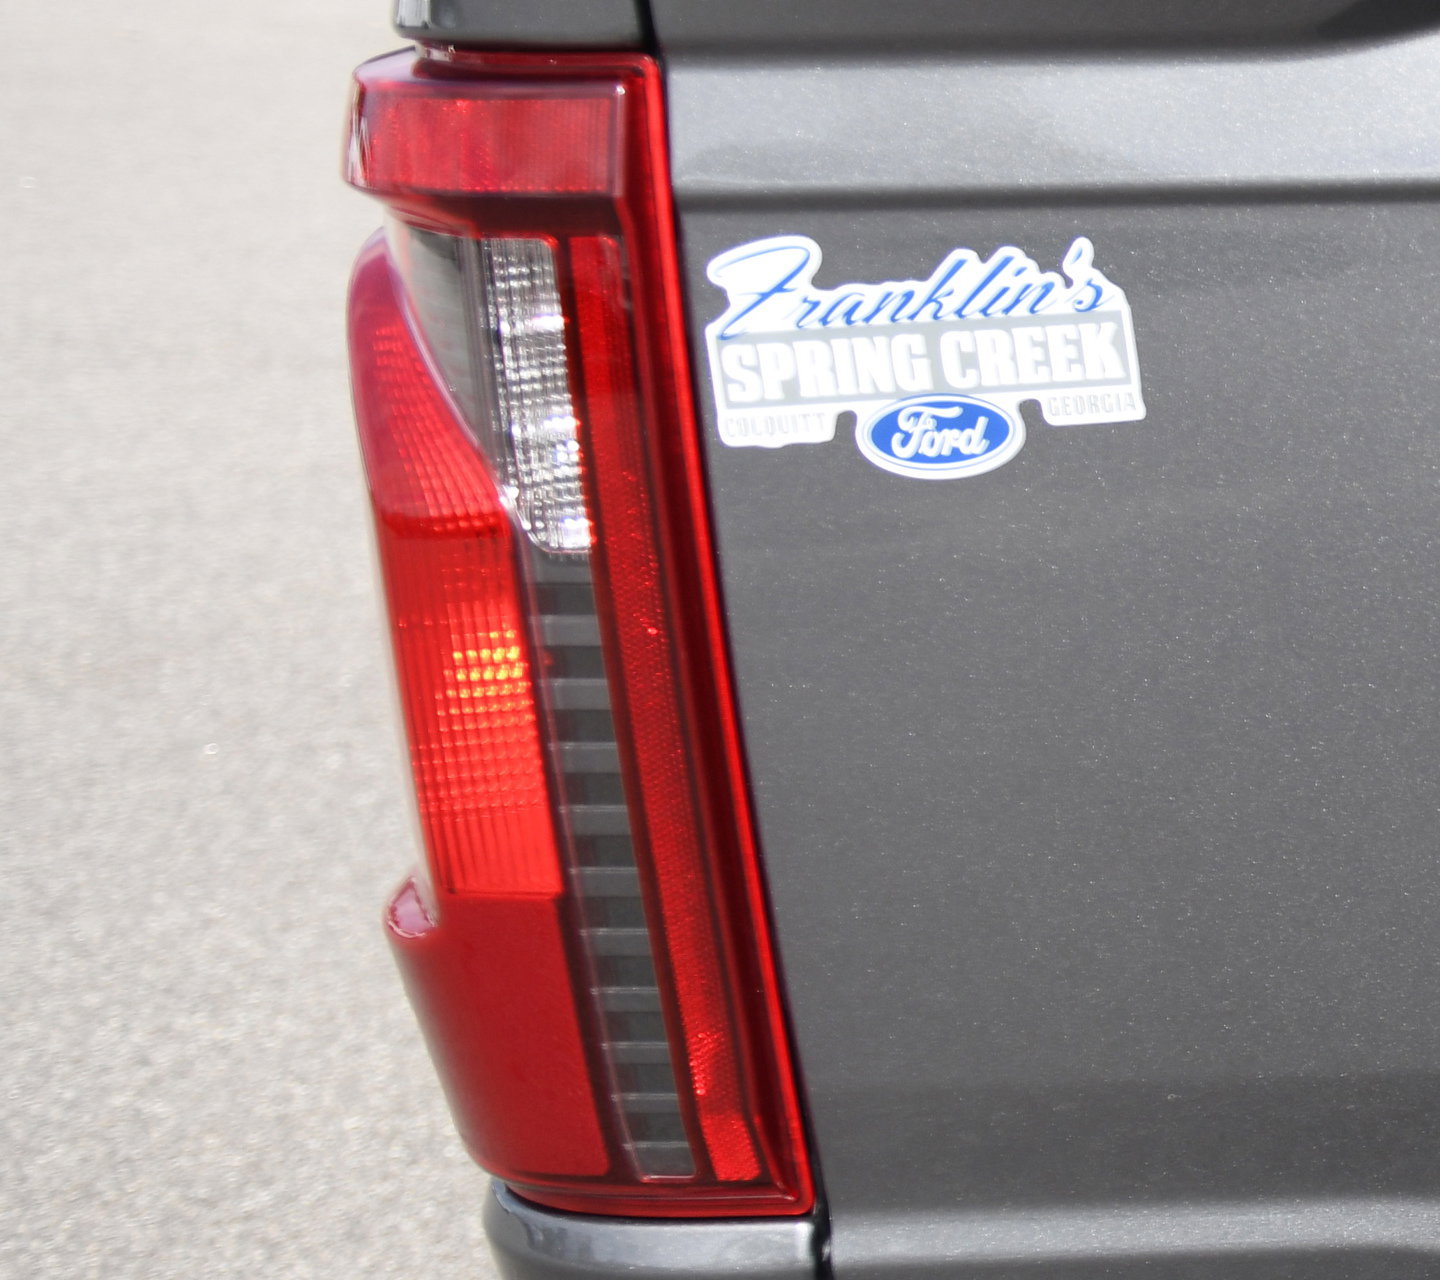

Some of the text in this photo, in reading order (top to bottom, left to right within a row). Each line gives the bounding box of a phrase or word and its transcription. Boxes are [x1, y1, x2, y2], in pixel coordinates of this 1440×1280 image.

[712, 244, 1118, 341] Franklin's
[720, 321, 1126, 404] SPRING CREEK
[724, 412, 827, 439] COLQUITT
[891, 405, 991, 460] Ford
[1046, 392, 1137, 418] GEORGIA
